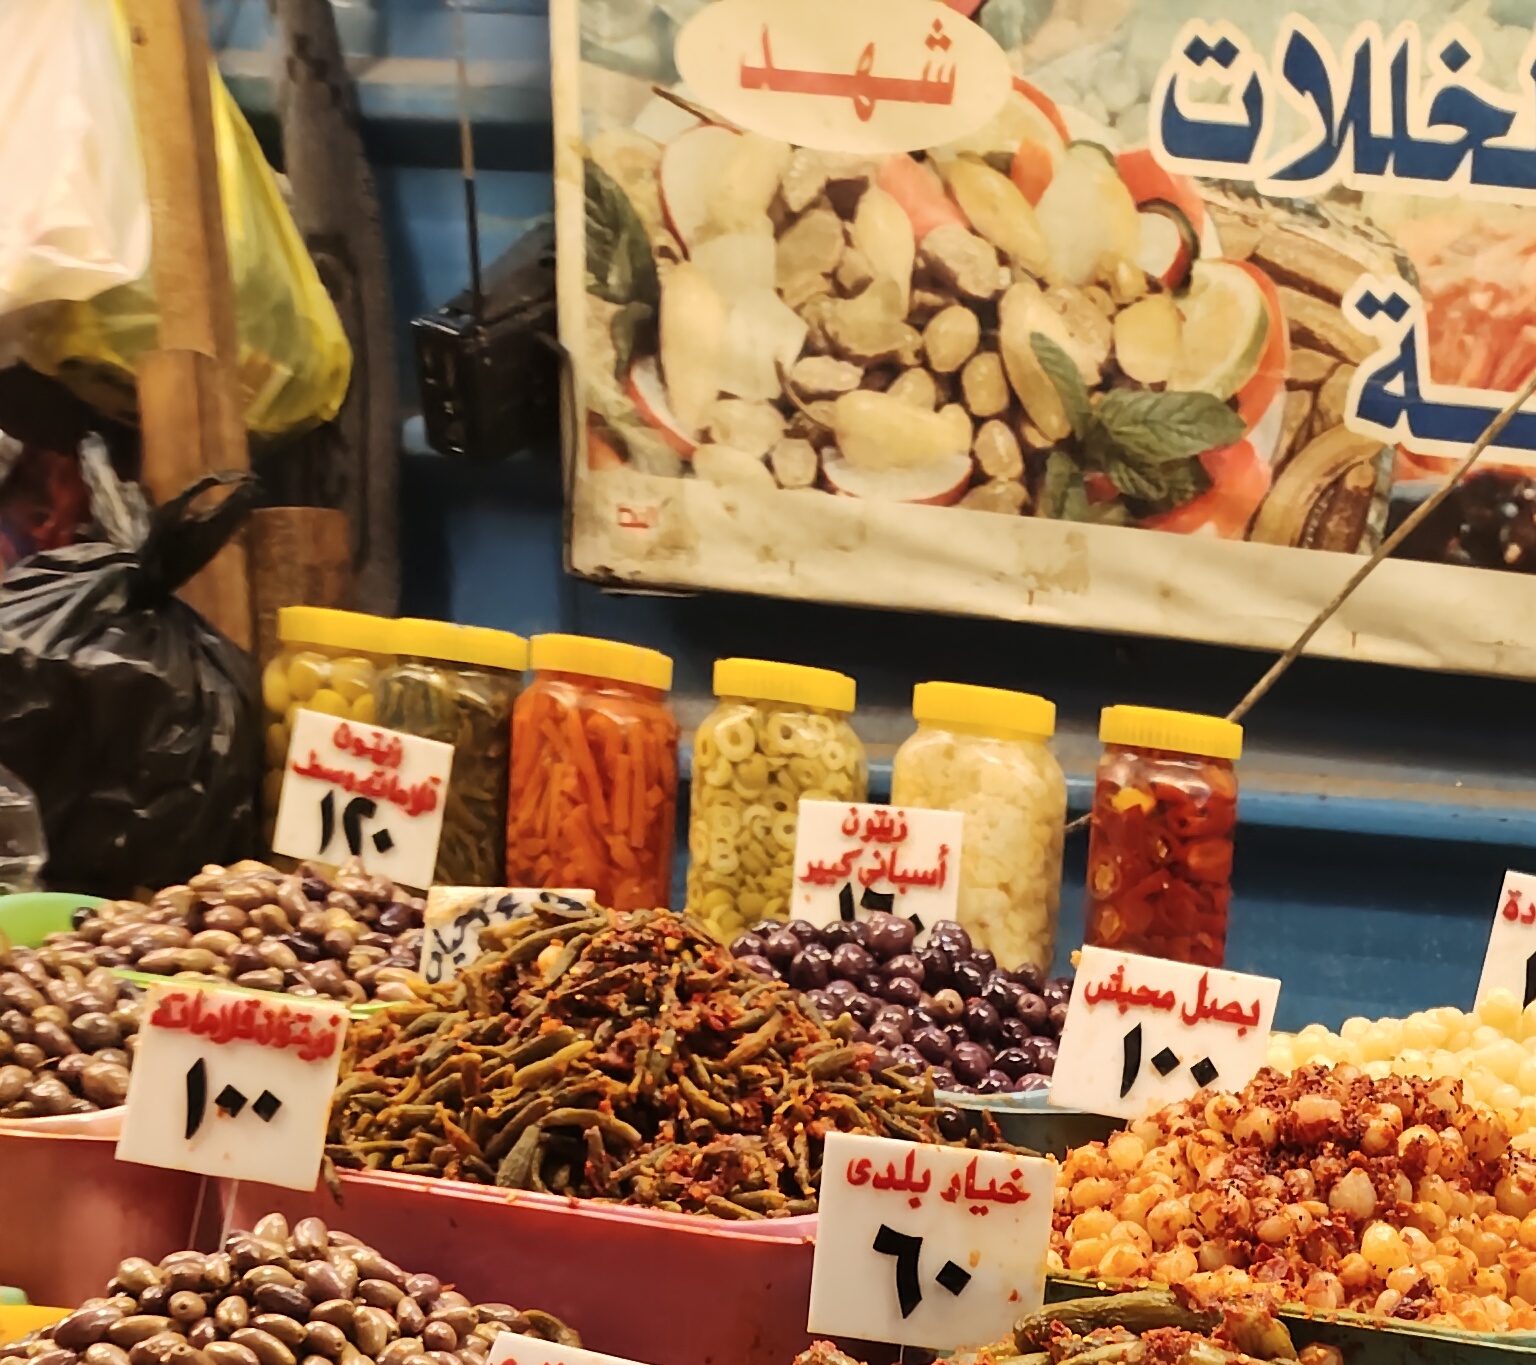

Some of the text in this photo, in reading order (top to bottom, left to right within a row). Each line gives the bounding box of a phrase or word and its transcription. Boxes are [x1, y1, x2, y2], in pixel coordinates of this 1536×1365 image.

[739, 18, 956, 122] شهد
[842, 797, 909, 843] زيتون
[1180, 970, 1261, 1038] بصل
[184, 1056, 284, 1141] ١٠٠
[1119, 1021, 1220, 1100] ١٠٠
[939, 1155, 1032, 1217] خيار
[872, 1223, 972, 1320] ٦٠
